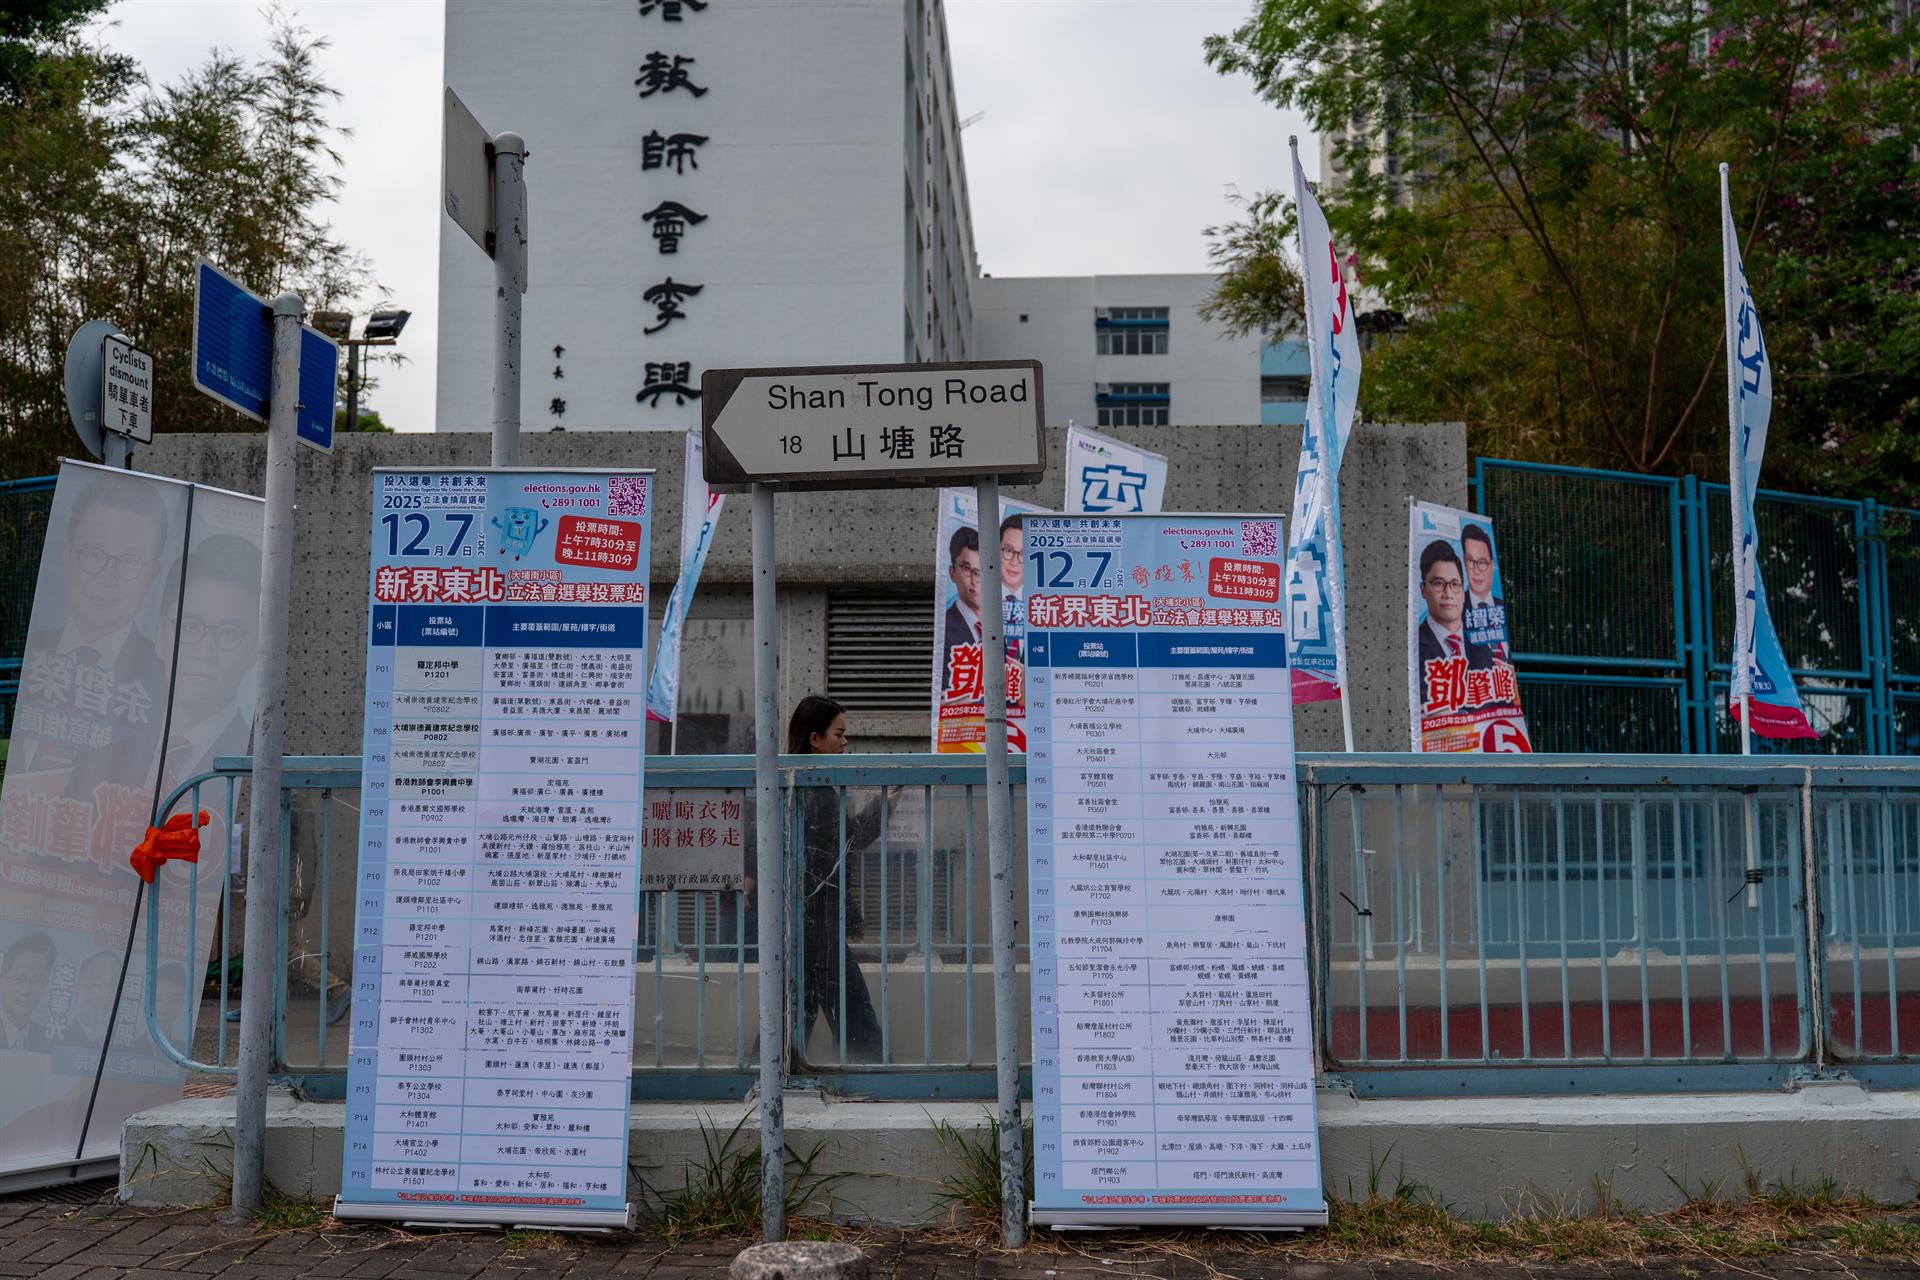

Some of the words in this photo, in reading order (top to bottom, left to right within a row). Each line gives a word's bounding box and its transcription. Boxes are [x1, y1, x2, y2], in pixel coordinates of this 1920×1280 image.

[113, 347, 146, 371] Cyclists
[110, 366, 149, 389] dismount
[108, 383, 149, 412] 騎單車者
[768, 384, 844, 410] Shan
[858, 381, 933, 411] Tong
[945, 378, 1027, 404] Road
[119, 408, 138, 429] 下車
[780, 436, 802, 454] 18
[833, 424, 965, 461] 山塘路
[384, 476, 432, 486] 投入選舉
[440, 476, 486, 486] 共創未來
[524, 484, 600, 495] elections.gov.hk
[384, 496, 422, 508] 2025
[423, 496, 486, 504] 立法會換屆選舉
[552, 498, 575, 507] 2891
[578, 498, 600, 508] 1001
[576, 521, 623, 536] 投票時間:
[1030, 520, 1071, 528] 投入選舉
[1080, 520, 1121, 528] 共創未來
[381, 513, 472, 556] 12月7日
[1163, 527, 1234, 536] elections.gov.hk
[562, 534, 636, 552] 上午7時30分至
[1030, 536, 1064, 547] 2025
[1190, 540, 1211, 548] 2891
[1214, 540, 1235, 548] 1001
[562, 548, 633, 565] 晚上11時30分
[1029, 551, 1112, 588] 12月7日
[1224, 562, 1264, 574] 投票時間:
[377, 567, 504, 602] 新界東北
[508, 570, 562, 582] (大埔南小區)
[1212, 572, 1276, 588] 上午7時30分至
[507, 584, 643, 602] 立法會選舉投票站
[1213, 584, 1274, 598] 晚上11時30分
[1029, 594, 1149, 626] 新界東北
[1154, 598, 1205, 607] (大埔北小區)
[376, 621, 392, 630] 小區
[428, 616, 452, 625] 投票站
[1154, 609, 1281, 626] 立法會選舉投票站
[422, 627, 458, 637] (票站編號)
[376, 664, 389, 673] P01
[417, 661, 459, 670] 羅定邦中學
[1425, 656, 1515, 713] 鄧肇峰
[640, 873, 742, 884] 港特別行政區政府示
[409, 924, 445, 932] 羅定邦中學
[404, 952, 448, 960] 挪威國際學校
[390, 1017, 456, 1025] 獅子會林村青年中心
[399, 1054, 443, 1063] 圍頭村村公所
[398, 1082, 442, 1091] 泰亨公立學校
[400, 1110, 436, 1119] 太和體育館
[395, 1139, 438, 1147] 大埔官立小學
[1091, 1167, 1127, 1176] 塔門鄉公所
